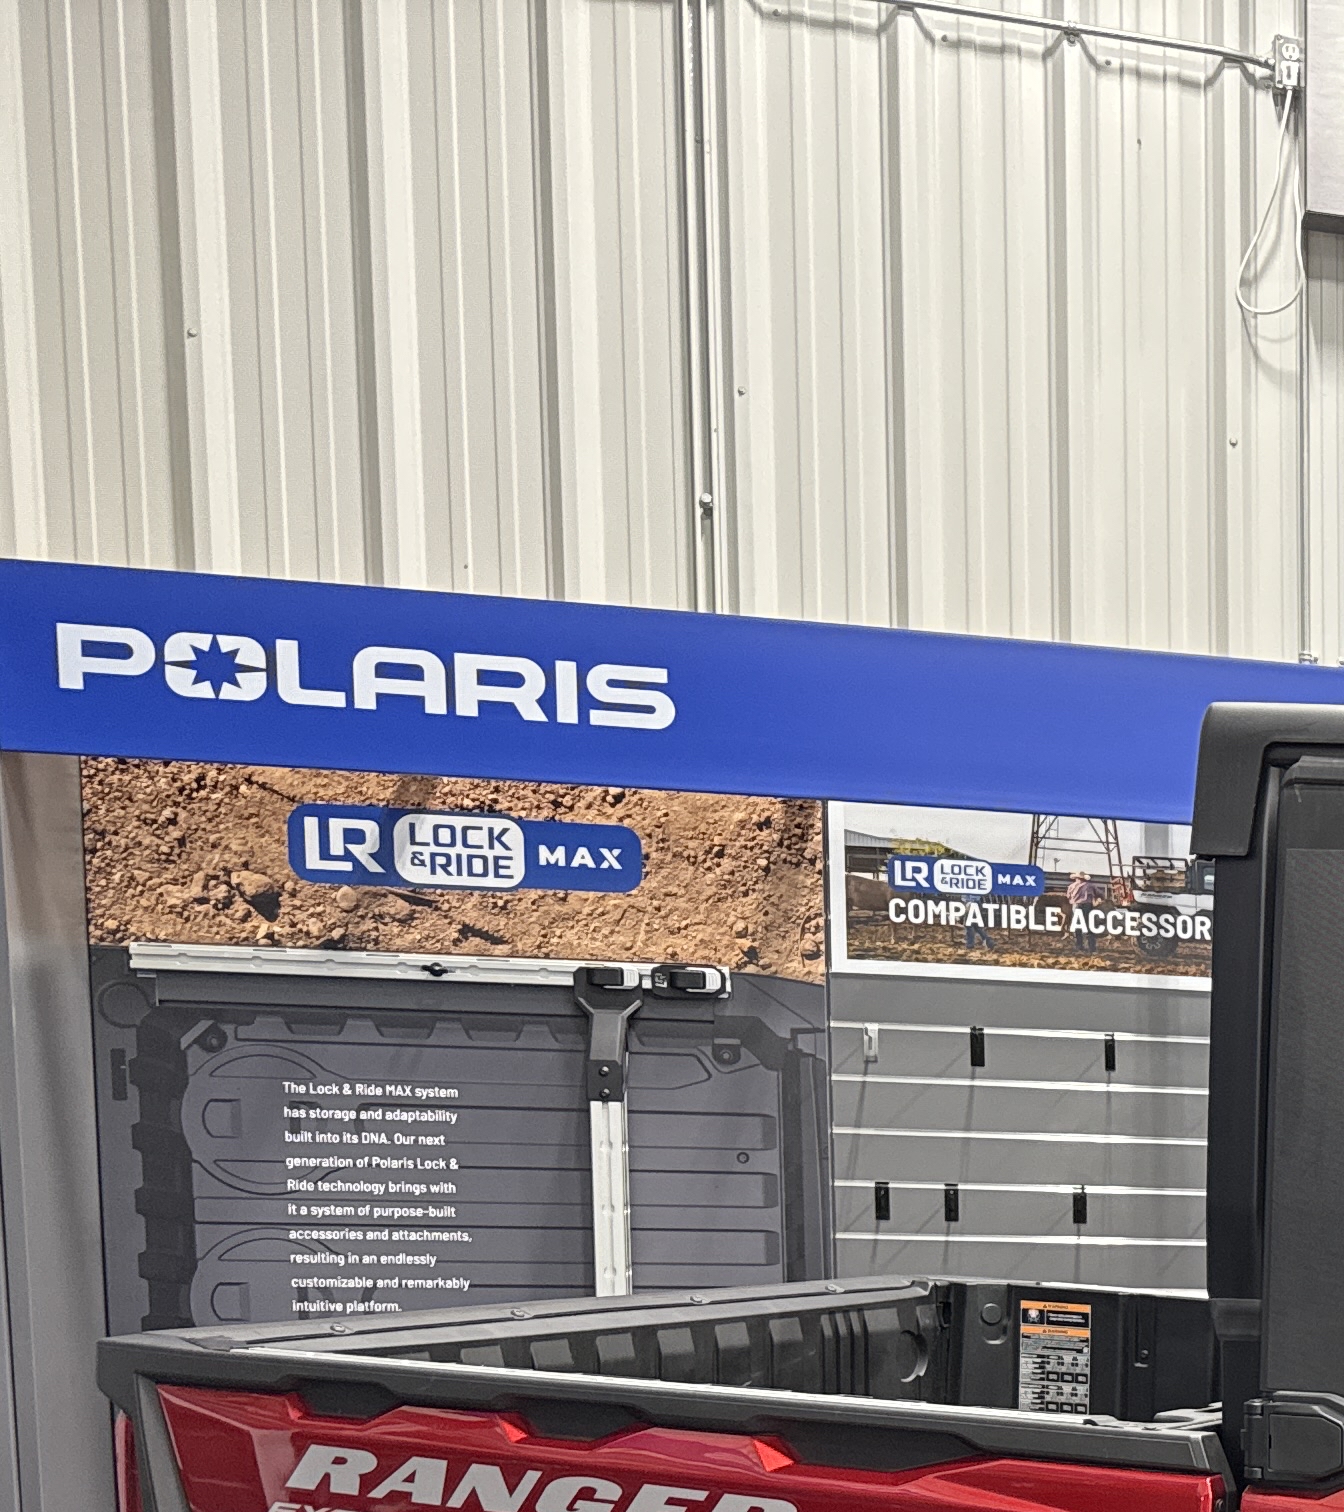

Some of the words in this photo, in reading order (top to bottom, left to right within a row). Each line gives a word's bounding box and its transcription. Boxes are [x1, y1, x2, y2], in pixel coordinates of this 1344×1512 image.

[56, 622, 677, 730] POLARIS
[407, 820, 513, 853] LOCK
[300, 815, 387, 874] LR
[538, 844, 624, 871] MAX
[940, 863, 987, 878] LOCK
[997, 874, 1037, 887] MAX
[888, 897, 1063, 932] COMPATIBLE
[1069, 907, 1212, 941] ACCESSOR
[283, 1082, 306, 1093] The
[310, 1083, 339, 1094] Lock
[343, 1084, 351, 1094] &
[356, 1084, 382, 1095] Ride
[386, 1085, 411, 1096] MAX
[415, 1087, 458, 1099] system
[284, 1106, 306, 1117] has
[310, 1109, 356, 1121] storage
[360, 1109, 382, 1119] and
[386, 1110, 457, 1123] adaptability
[285, 1131, 312, 1142] built
[316, 1132, 339, 1143] into
[343, 1132, 358, 1143] its
[362, 1133, 391, 1144] DNA.
[395, 1133, 415, 1145] Our
[419, 1136, 445, 1145] next
[286, 1156, 353, 1169] generation
[356, 1157, 369, 1167] of
[372, 1157, 414, 1168] Polaris
[417, 1158, 446, 1169] Lock
[450, 1159, 459, 1169] &
[287, 1180, 314, 1191] Ride
[318, 1181, 385, 1194] technology
[389, 1182, 427, 1195] brings
[430, 1182, 456, 1193] with
[288, 1204, 296, 1215] it
[300, 1207, 307, 1215] a
[311, 1206, 354, 1218] system
[358, 1205, 370, 1216] of
[374, 1207, 456, 1219] purpose-built
[289, 1229, 363, 1240] accessories
[367, 1230, 388, 1240] and
[392, 1230, 472, 1242] attachments,
[291, 1252, 344, 1265] resulting
[348, 1253, 359, 1263] in
[362, 1255, 377, 1264] an
[380, 1254, 436, 1266] endlessly
[292, 1277, 373, 1287] customizable
[377, 1277, 398, 1288] and
[402, 1278, 470, 1290] remarkably
[292, 1300, 342, 1311] intuitive
[347, 1302, 401, 1313] platform.
